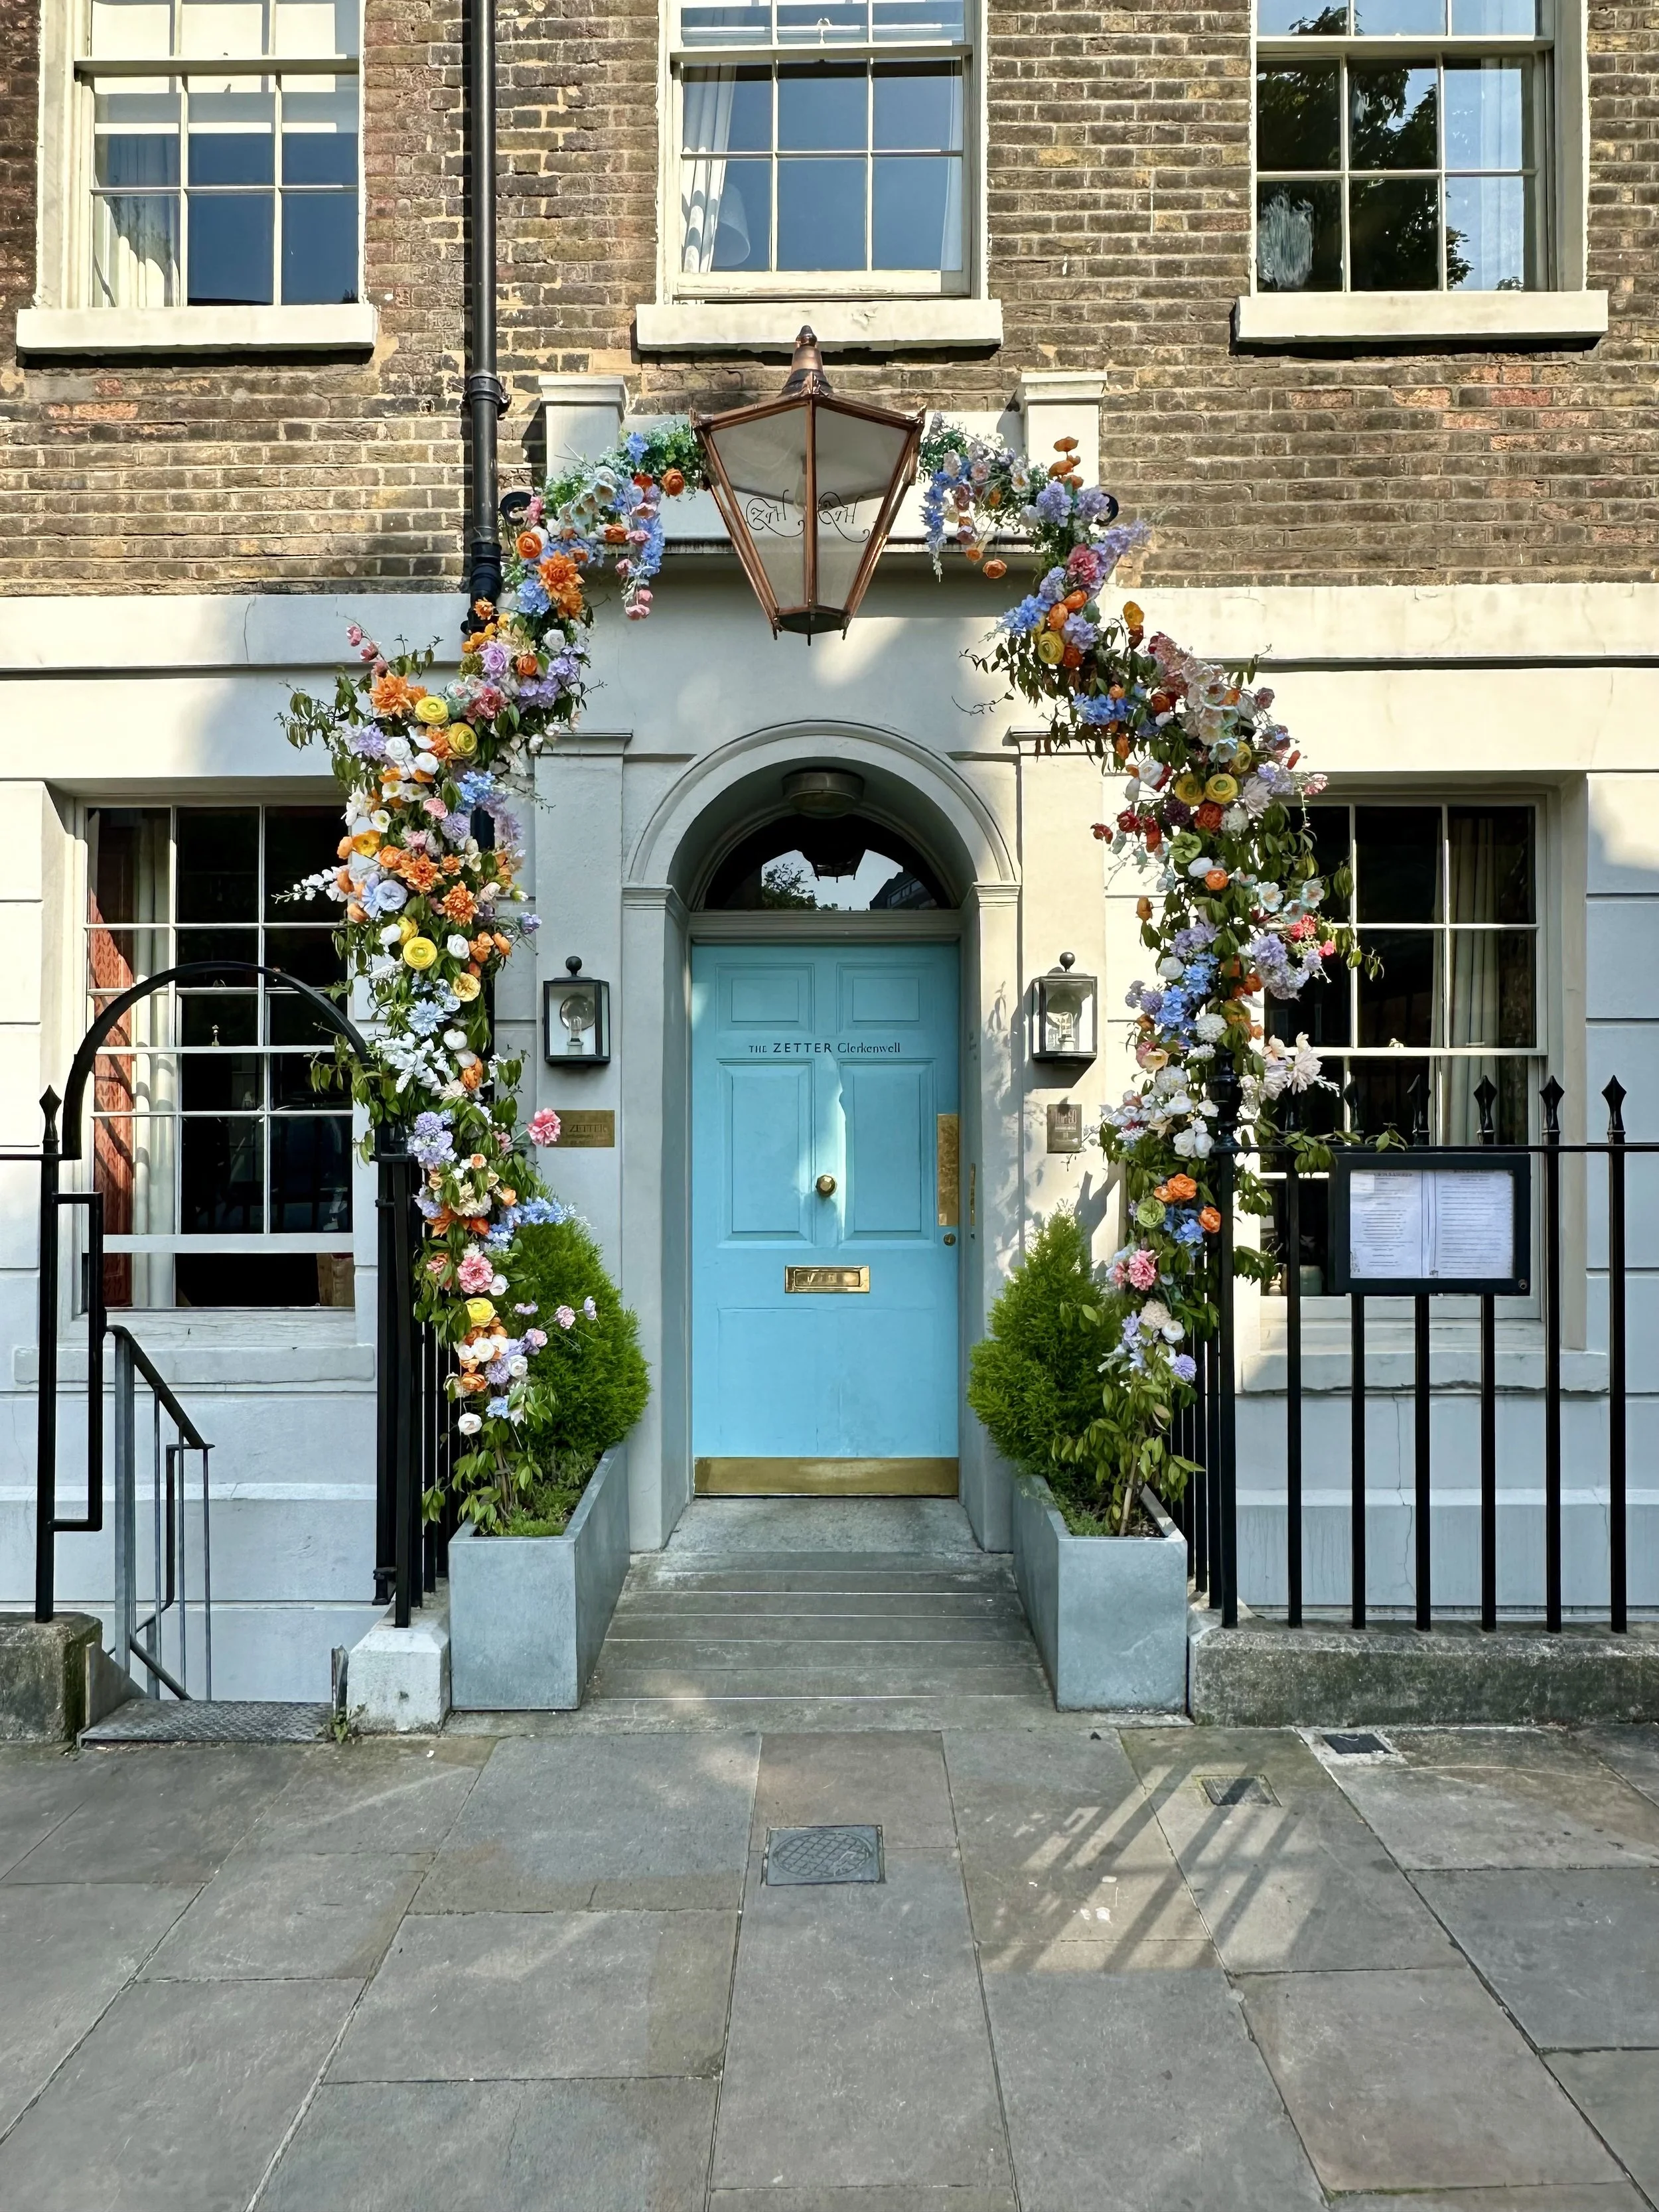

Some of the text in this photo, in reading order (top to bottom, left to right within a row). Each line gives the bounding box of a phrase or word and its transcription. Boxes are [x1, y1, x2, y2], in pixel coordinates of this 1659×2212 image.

[749, 1042, 901, 1053] THE ZETTER Clerkenwell
